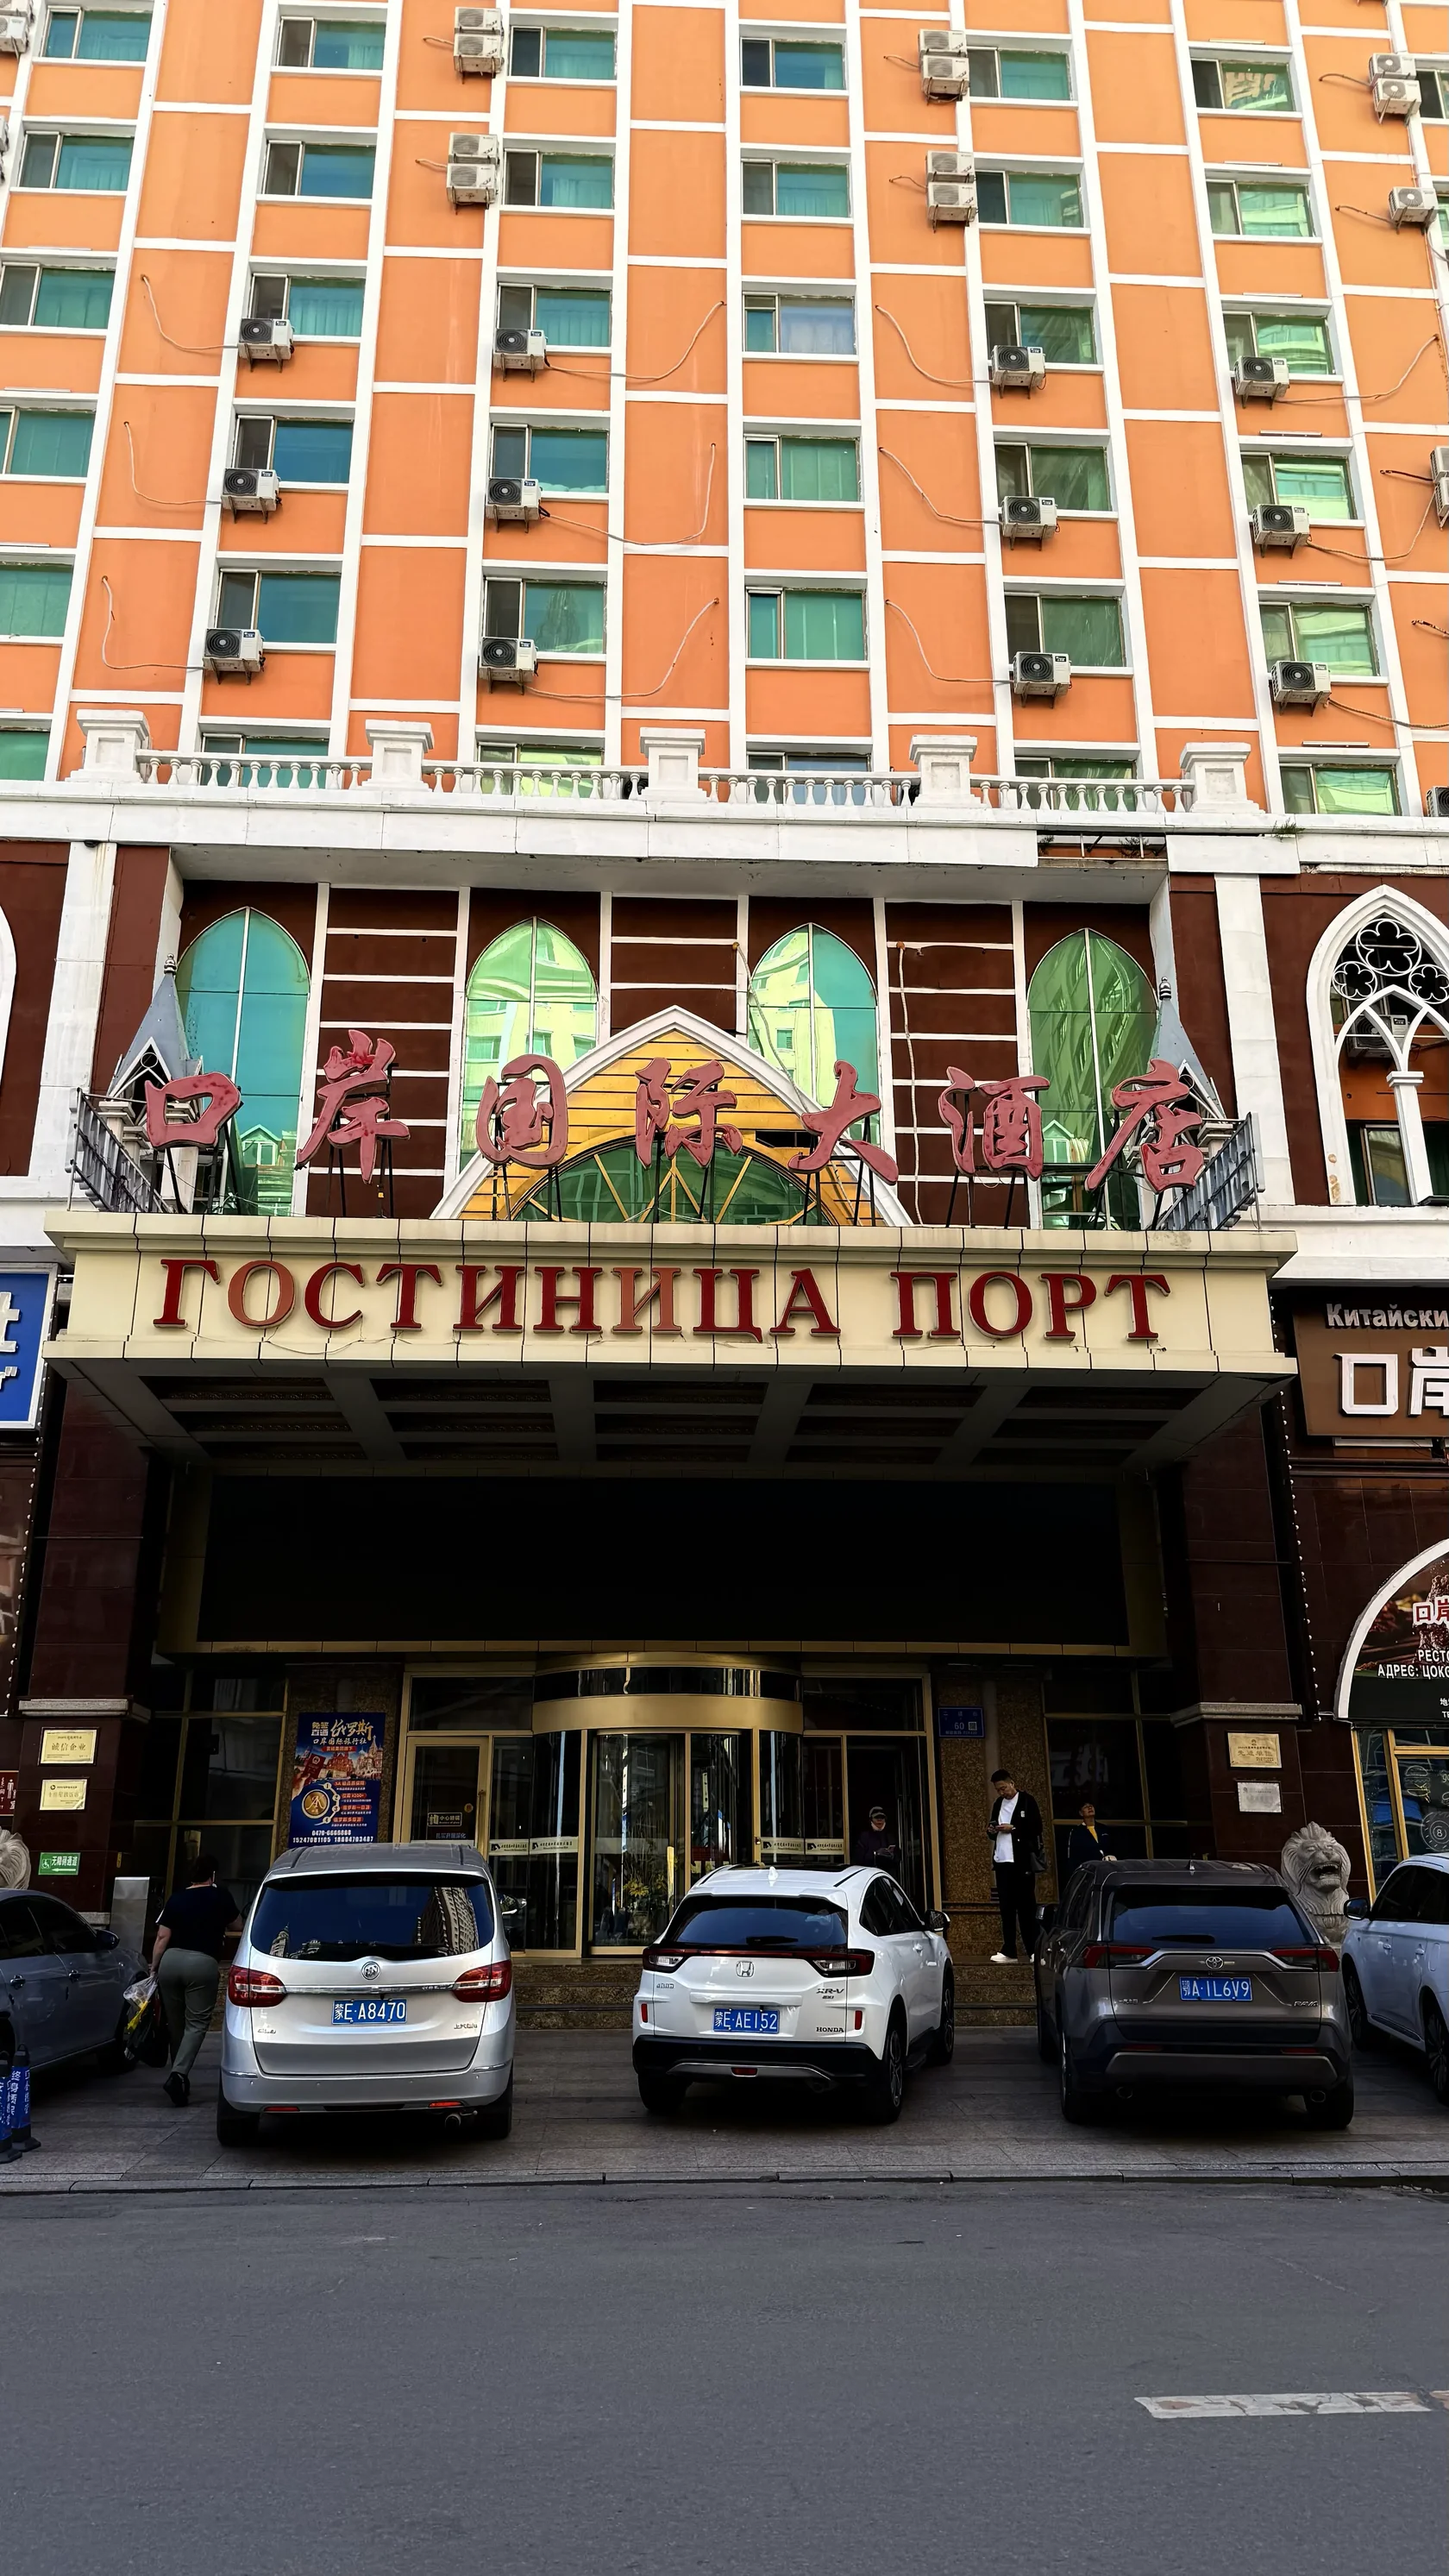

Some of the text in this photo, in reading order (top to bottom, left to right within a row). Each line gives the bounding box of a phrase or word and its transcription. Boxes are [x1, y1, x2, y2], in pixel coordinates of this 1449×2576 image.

[145, 1029, 1205, 1193] 口岸国际大酒店
[153, 1258, 1171, 1343] ГОСТИНИЦА ПОРТ
[1326, 1303, 1449, 1328] Китайски
[1377, 1664, 1419, 1679] АДРЕС:
[330, 1718, 374, 1741] 俄罗斯
